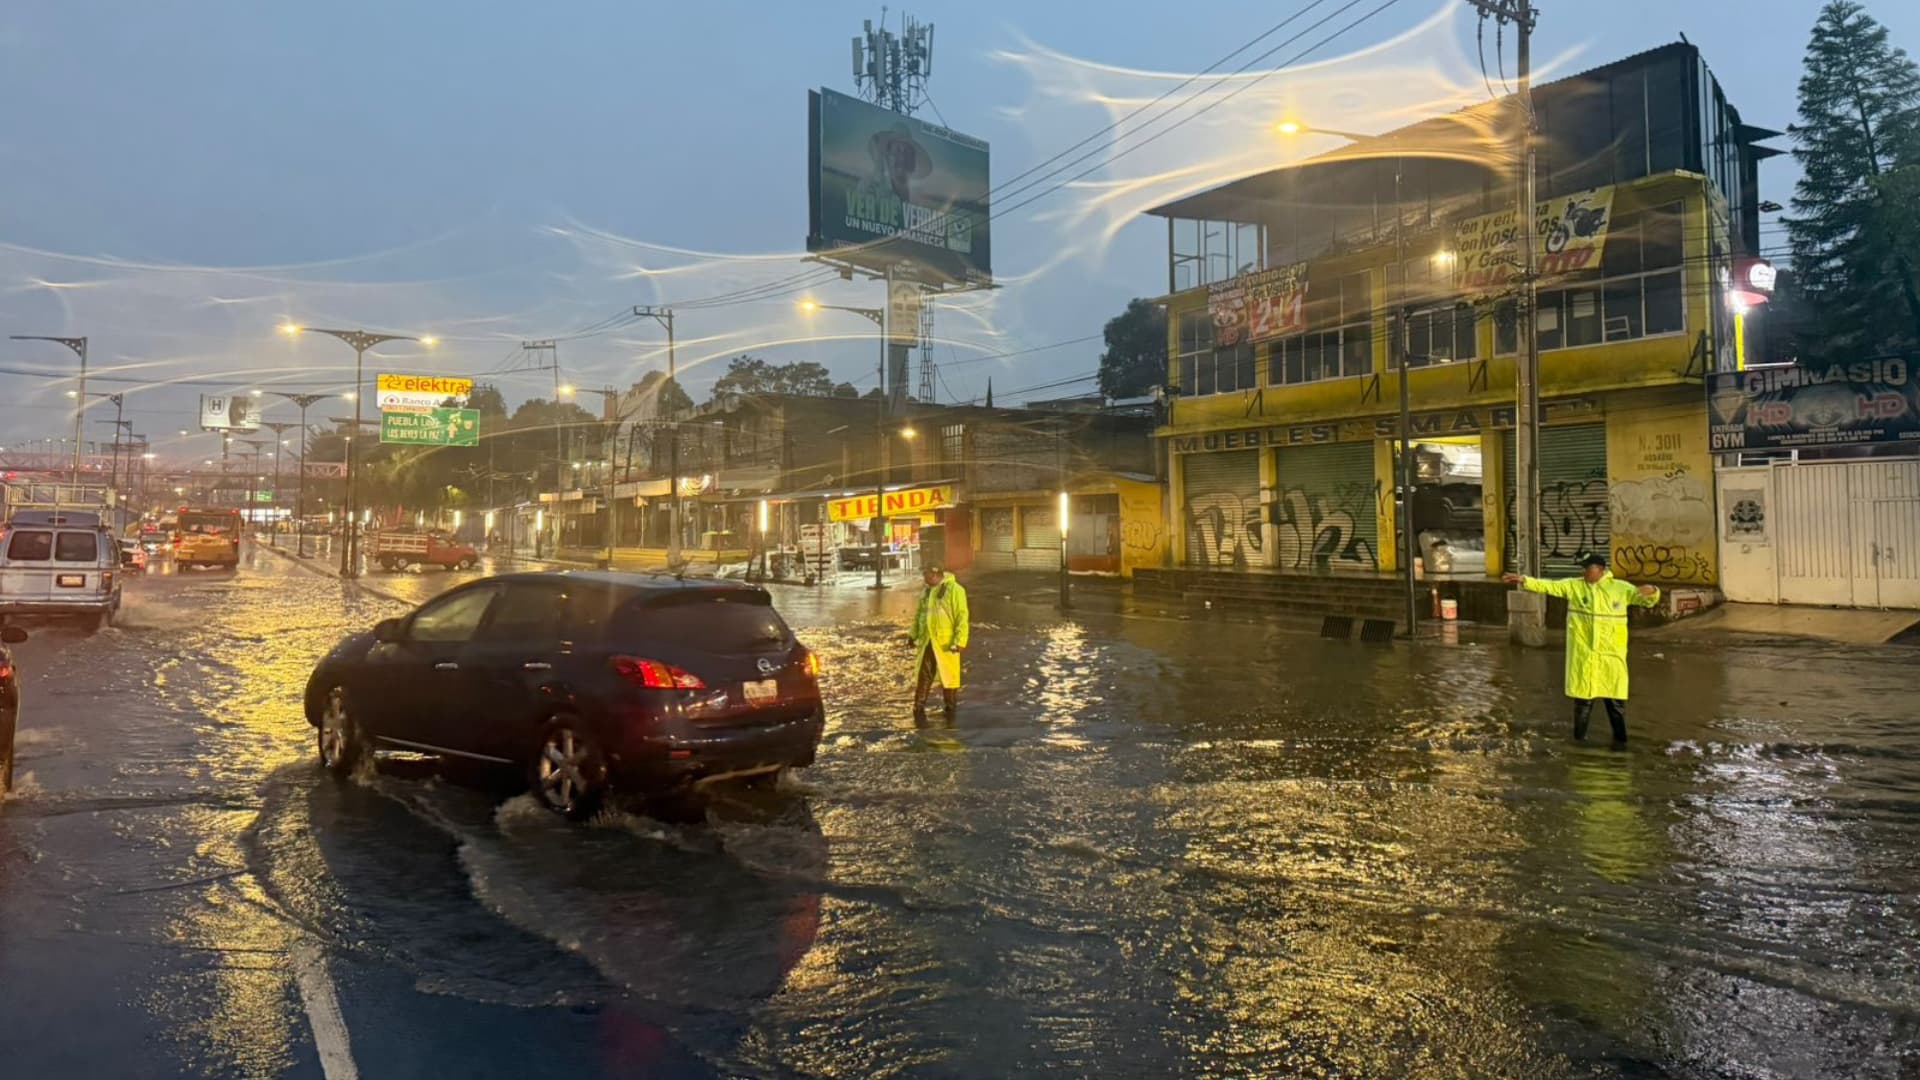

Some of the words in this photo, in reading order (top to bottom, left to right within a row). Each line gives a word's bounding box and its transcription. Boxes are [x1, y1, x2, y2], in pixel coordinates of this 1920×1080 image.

[845, 215, 860, 229] UN
[862, 220, 895, 237] NUEVO
[902, 202, 946, 236] VERDAD
[404, 377, 465, 393] elektra
[1743, 358, 1907, 397] GIMNASIO
[388, 416, 418, 426] PUEBLA
[1174, 424, 1330, 451] MUEBLES
[1655, 433, 1681, 451] 3011
[1712, 432, 1745, 449] GYM
[836, 488, 944, 517] TIENDA
